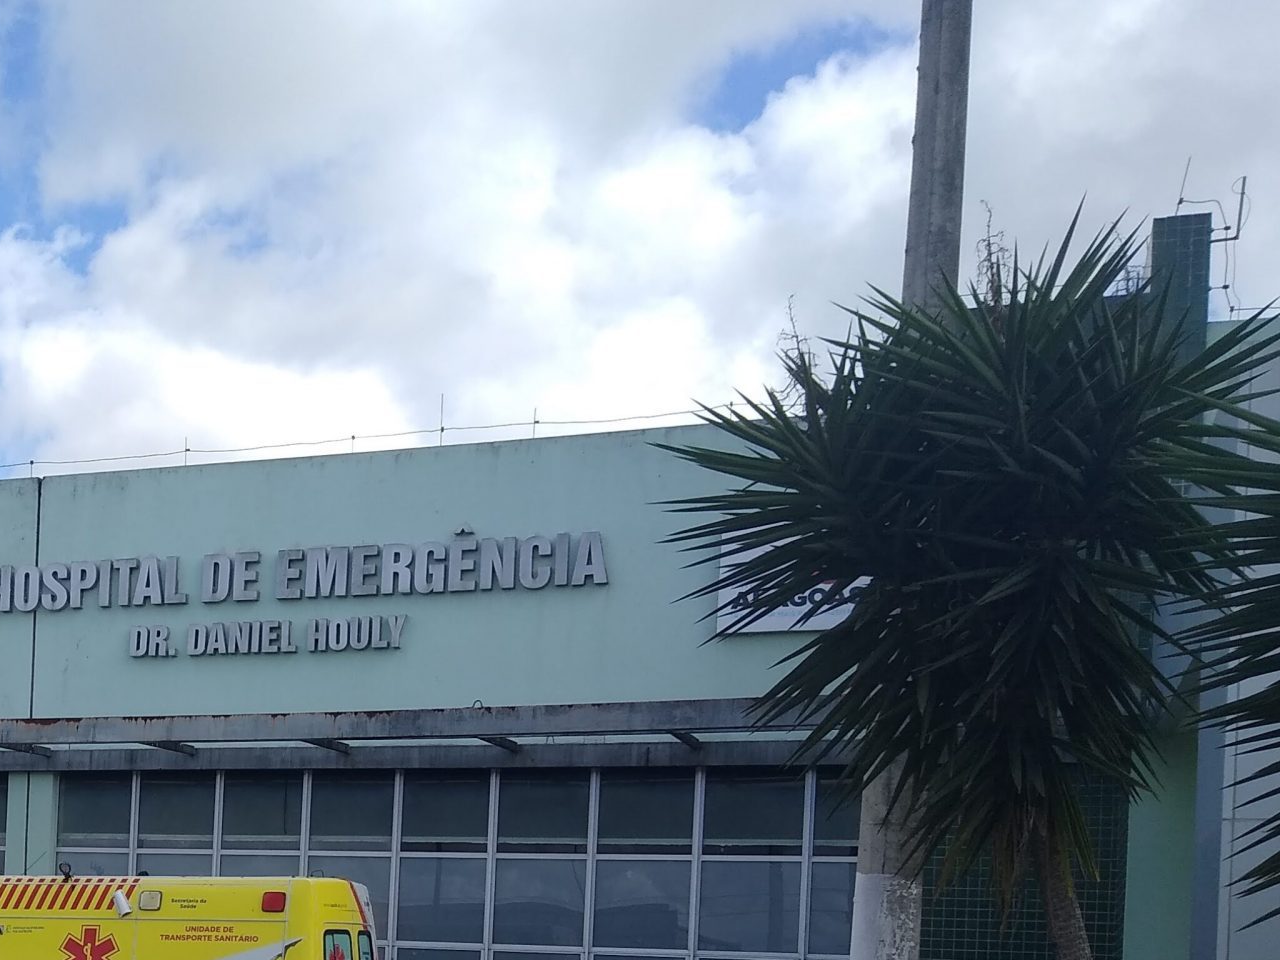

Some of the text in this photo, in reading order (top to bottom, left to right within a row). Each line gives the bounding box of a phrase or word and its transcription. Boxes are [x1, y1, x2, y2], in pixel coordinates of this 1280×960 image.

[202, 551, 260, 604] DE
[276, 526, 608, 600] EMERGÊNCIA
[128, 614, 407, 657] DR. DANIEL HOULY
[160, 934, 213, 942] TRANSPORTE
[185, 925, 221, 933] UNIDADE
